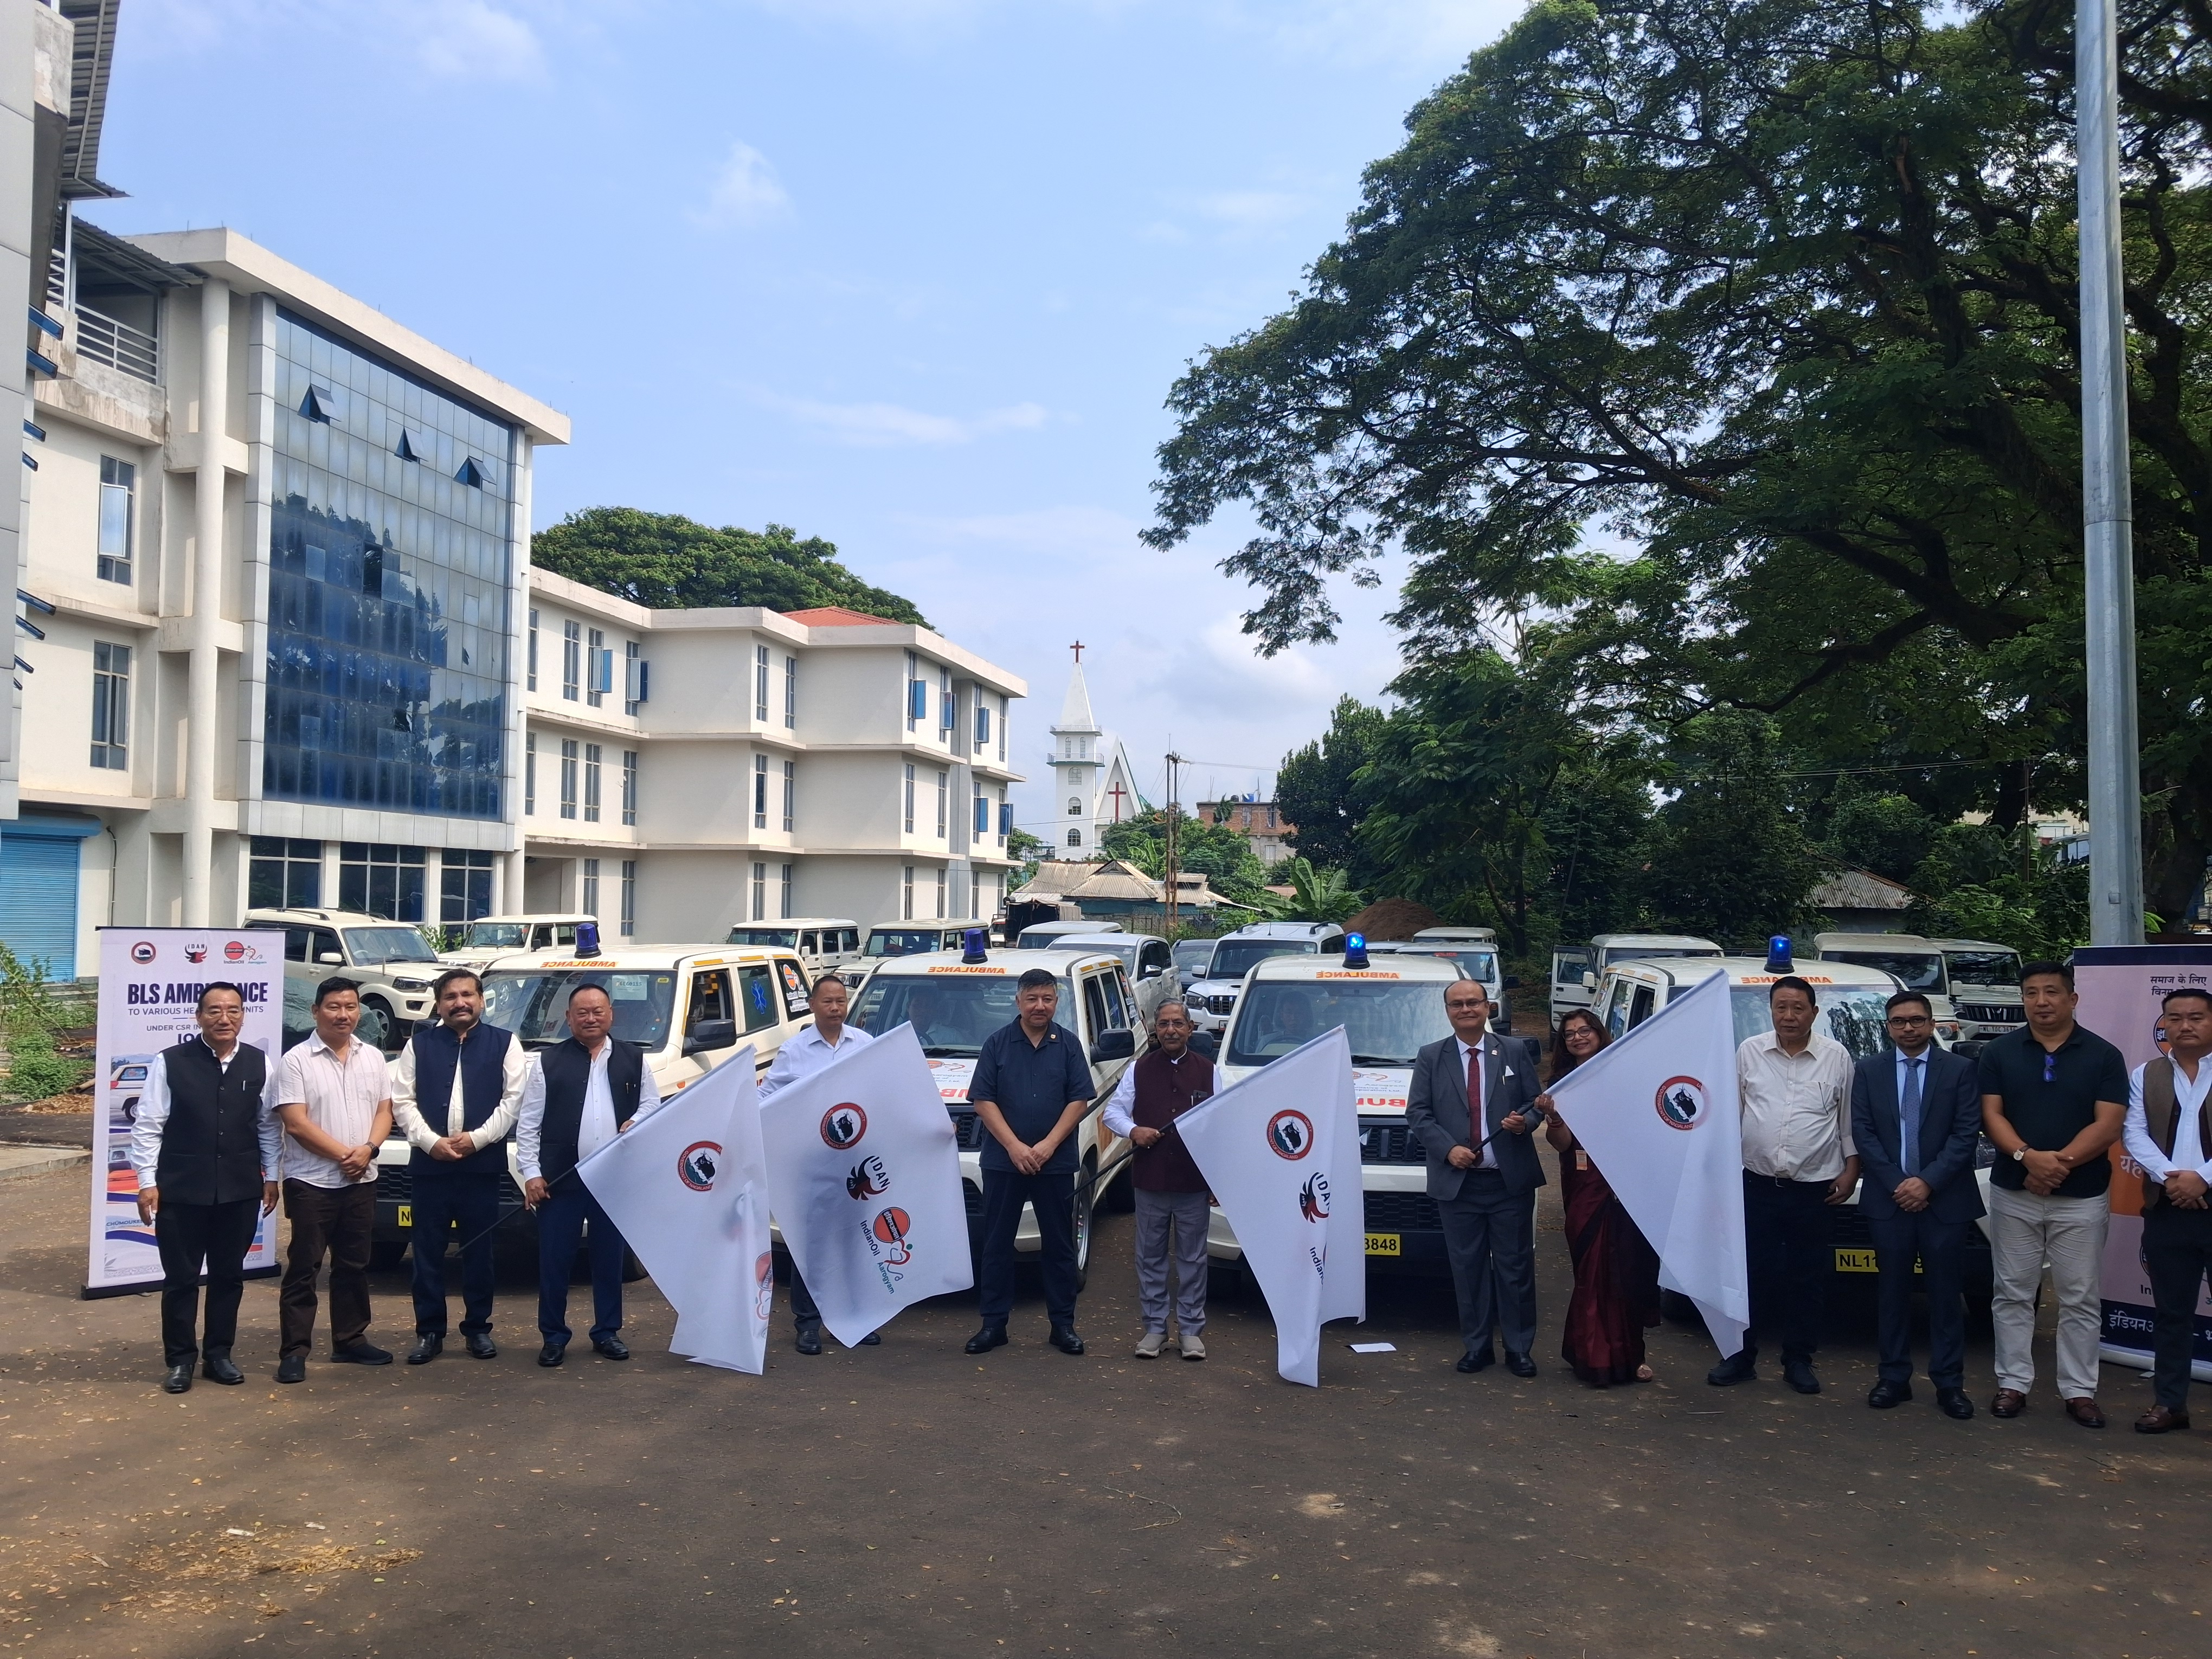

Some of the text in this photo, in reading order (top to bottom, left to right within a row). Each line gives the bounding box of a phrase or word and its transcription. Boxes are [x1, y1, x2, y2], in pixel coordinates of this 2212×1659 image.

[127, 982, 268, 1005] BLS AMBNCE
[2150, 974, 2208, 986] समाज के लिए
[870, 1156, 891, 1188] IDAN
[860, 1220, 881, 1257] IndianOil
[877, 1262, 895, 1295] Aarogyam
[1309, 1246, 1324, 1284] Indian
